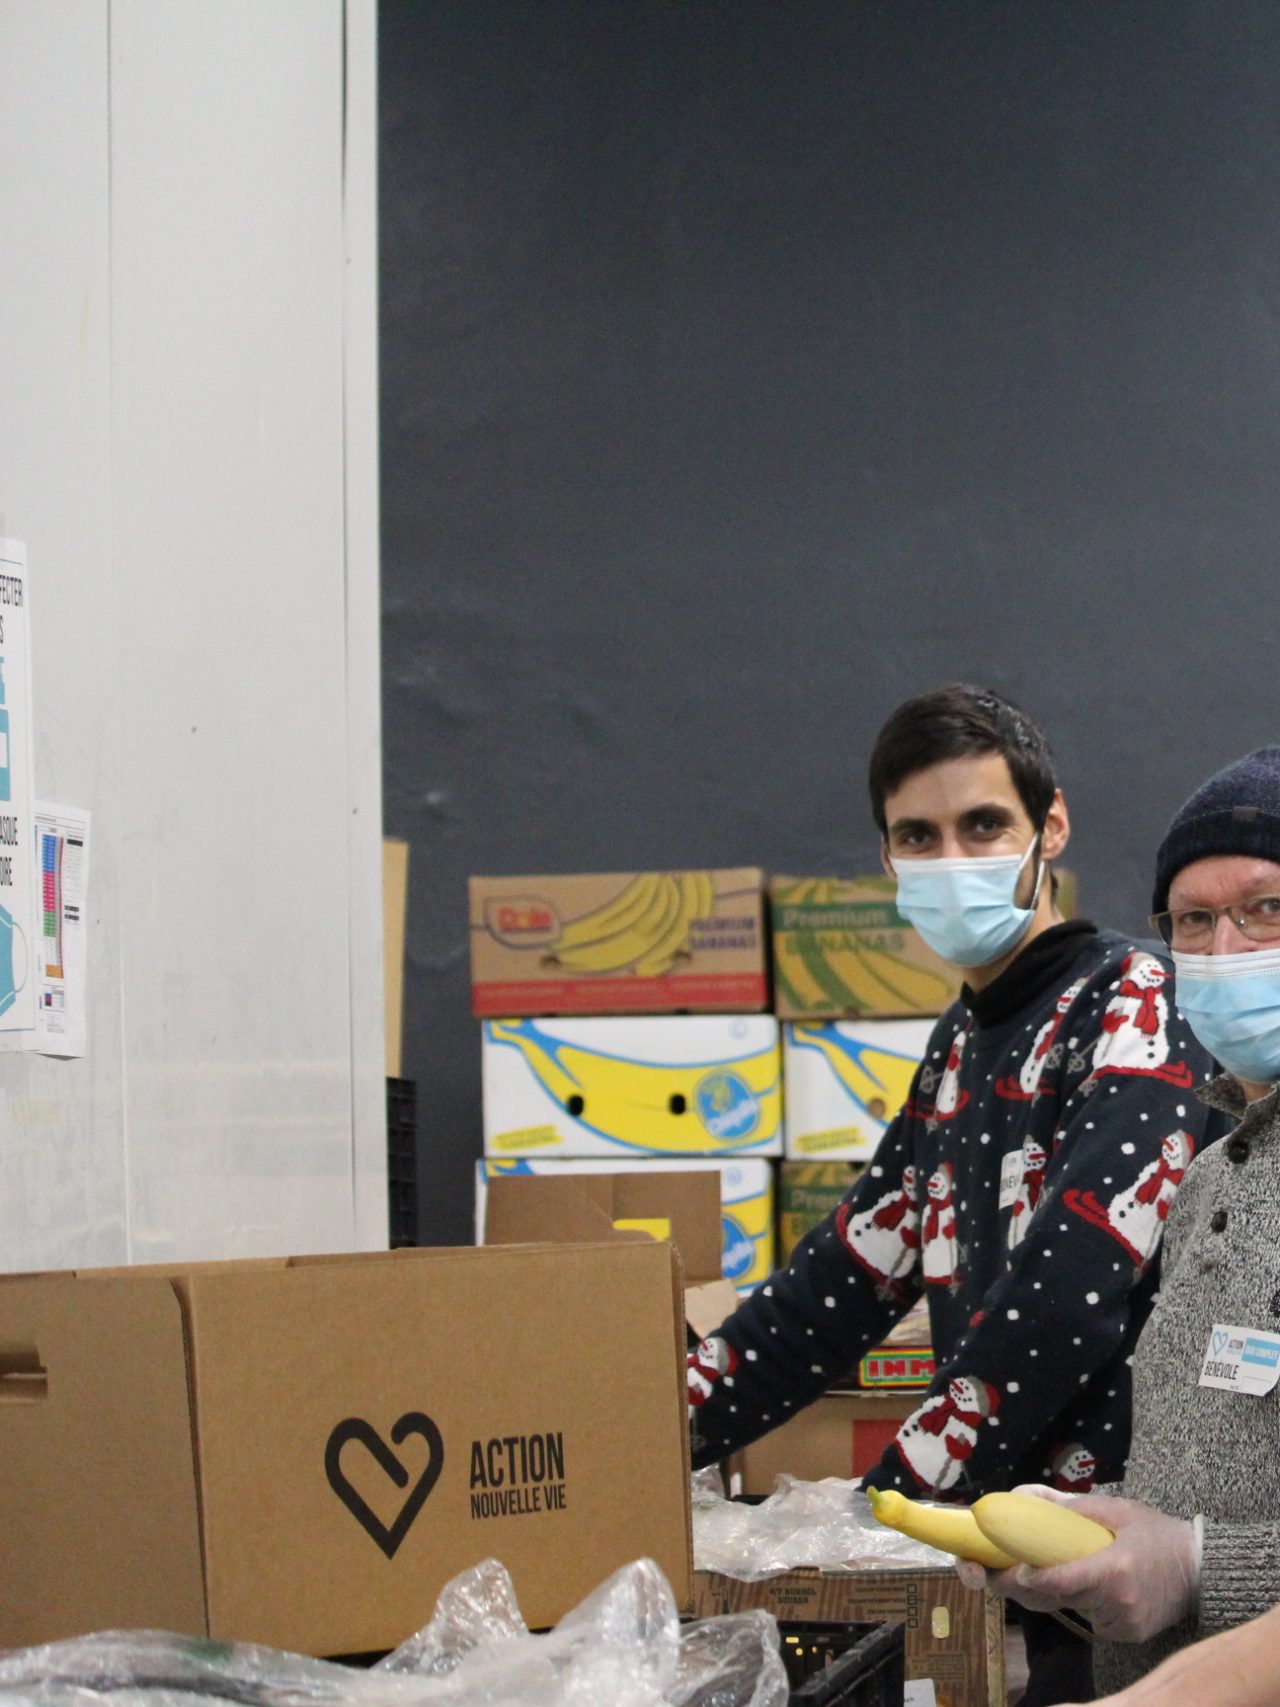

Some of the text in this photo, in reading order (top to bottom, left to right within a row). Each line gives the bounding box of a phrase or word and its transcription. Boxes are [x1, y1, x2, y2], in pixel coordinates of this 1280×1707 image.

[783, 908, 888, 928] Premium
[784, 930, 904, 953] BNANAS
[470, 1432, 564, 1490] ACTION
[471, 1484, 566, 1519] NOUVELLE VIE
